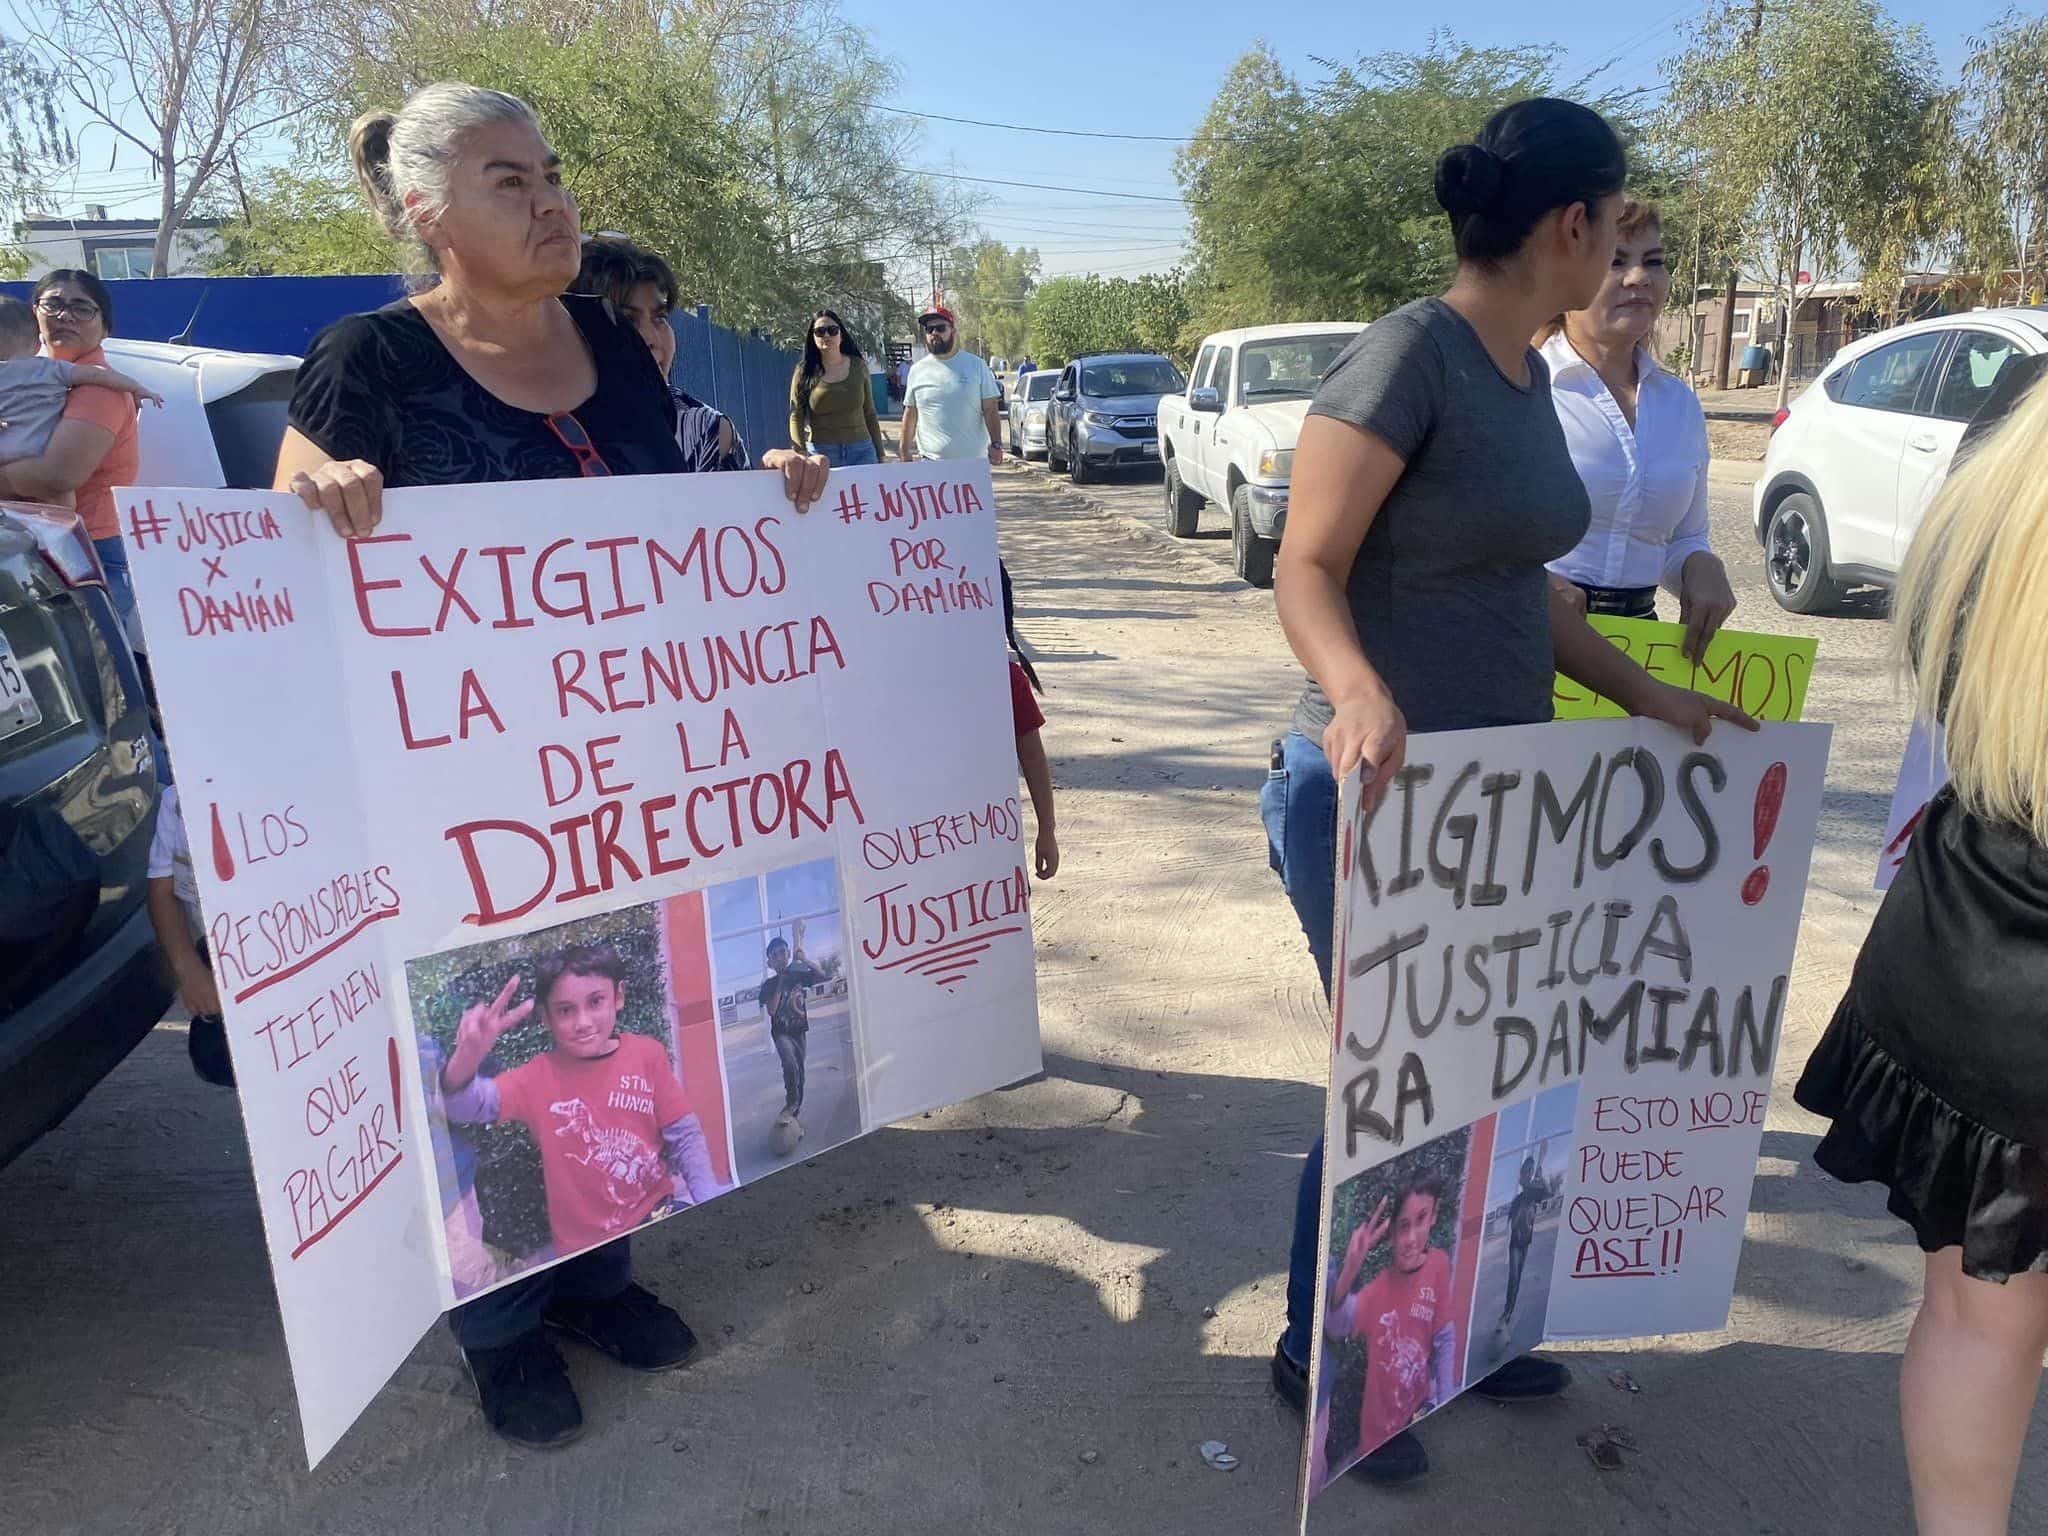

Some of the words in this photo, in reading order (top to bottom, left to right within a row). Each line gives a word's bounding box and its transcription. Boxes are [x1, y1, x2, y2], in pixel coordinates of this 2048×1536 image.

[130, 500, 282, 552] #JUSTICIA
[832, 480, 984, 530] #JUSTICIA
[346, 517, 787, 638] EXIGIMOS
[867, 566, 995, 616] DAMIÁN
[890, 537, 954, 577] POR
[178, 578, 294, 637] DAMIÁN
[391, 669, 506, 750] LA
[552, 615, 845, 718] RENUNCIA
[539, 735, 634, 807] DE
[676, 708, 751, 774] LA
[444, 749, 865, 927] DIRECTORA
[863, 797, 1018, 870] QUEREMOS
[211, 865, 400, 989] RESPONSABLES
[863, 865, 1030, 960] JUSTICIA
[255, 962, 381, 1072] TIENEN
[1346, 895, 1692, 1062] JUSTICIA
[306, 1056, 367, 1136] QUE
[1342, 1052, 1436, 1158] RA
[1492, 974, 1788, 1101] DAMIAN
[1594, 1096, 1679, 1134] ESTO
[1691, 1092, 1733, 1126] NO
[1732, 1091, 1767, 1125] SE
[1579, 1144, 1685, 1184] PUEDE
[1569, 1185, 1727, 1235] QUEDAR
